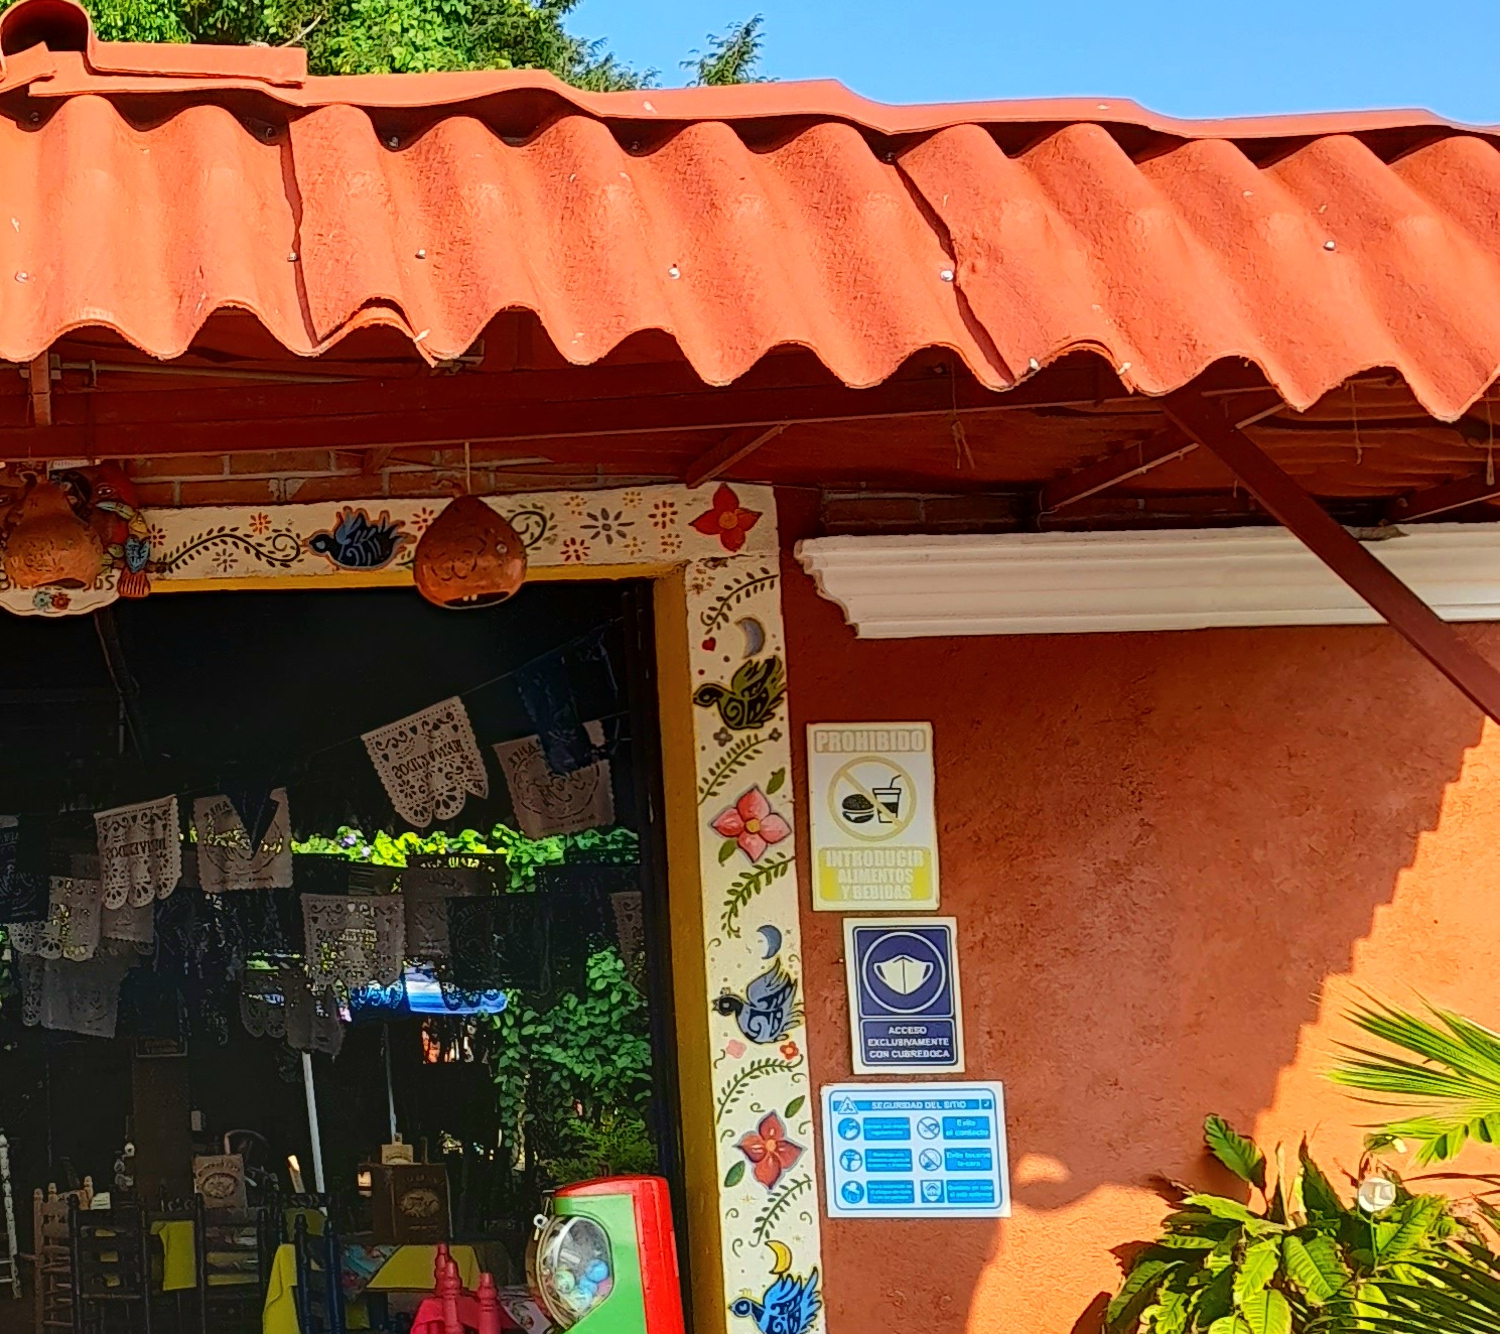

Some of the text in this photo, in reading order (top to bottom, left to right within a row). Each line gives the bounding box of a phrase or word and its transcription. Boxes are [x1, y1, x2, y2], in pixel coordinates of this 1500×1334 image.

[815, 730, 925, 752] PROHIBIDO
[826, 850, 924, 867] INTRODUCIR
[837, 868, 914, 884] ALIMENTOS
[841, 885, 912, 900] Y BEBIDAS
[888, 1026, 927, 1034] ACCESO
[867, 1037, 950, 1046] EXCLUSIVAMENTE
[869, 1049, 950, 1058] CON CUBREBOCA
[871, 1101, 923, 1110] SEGURIDAD
[925, 1101, 941, 1109] DEL
